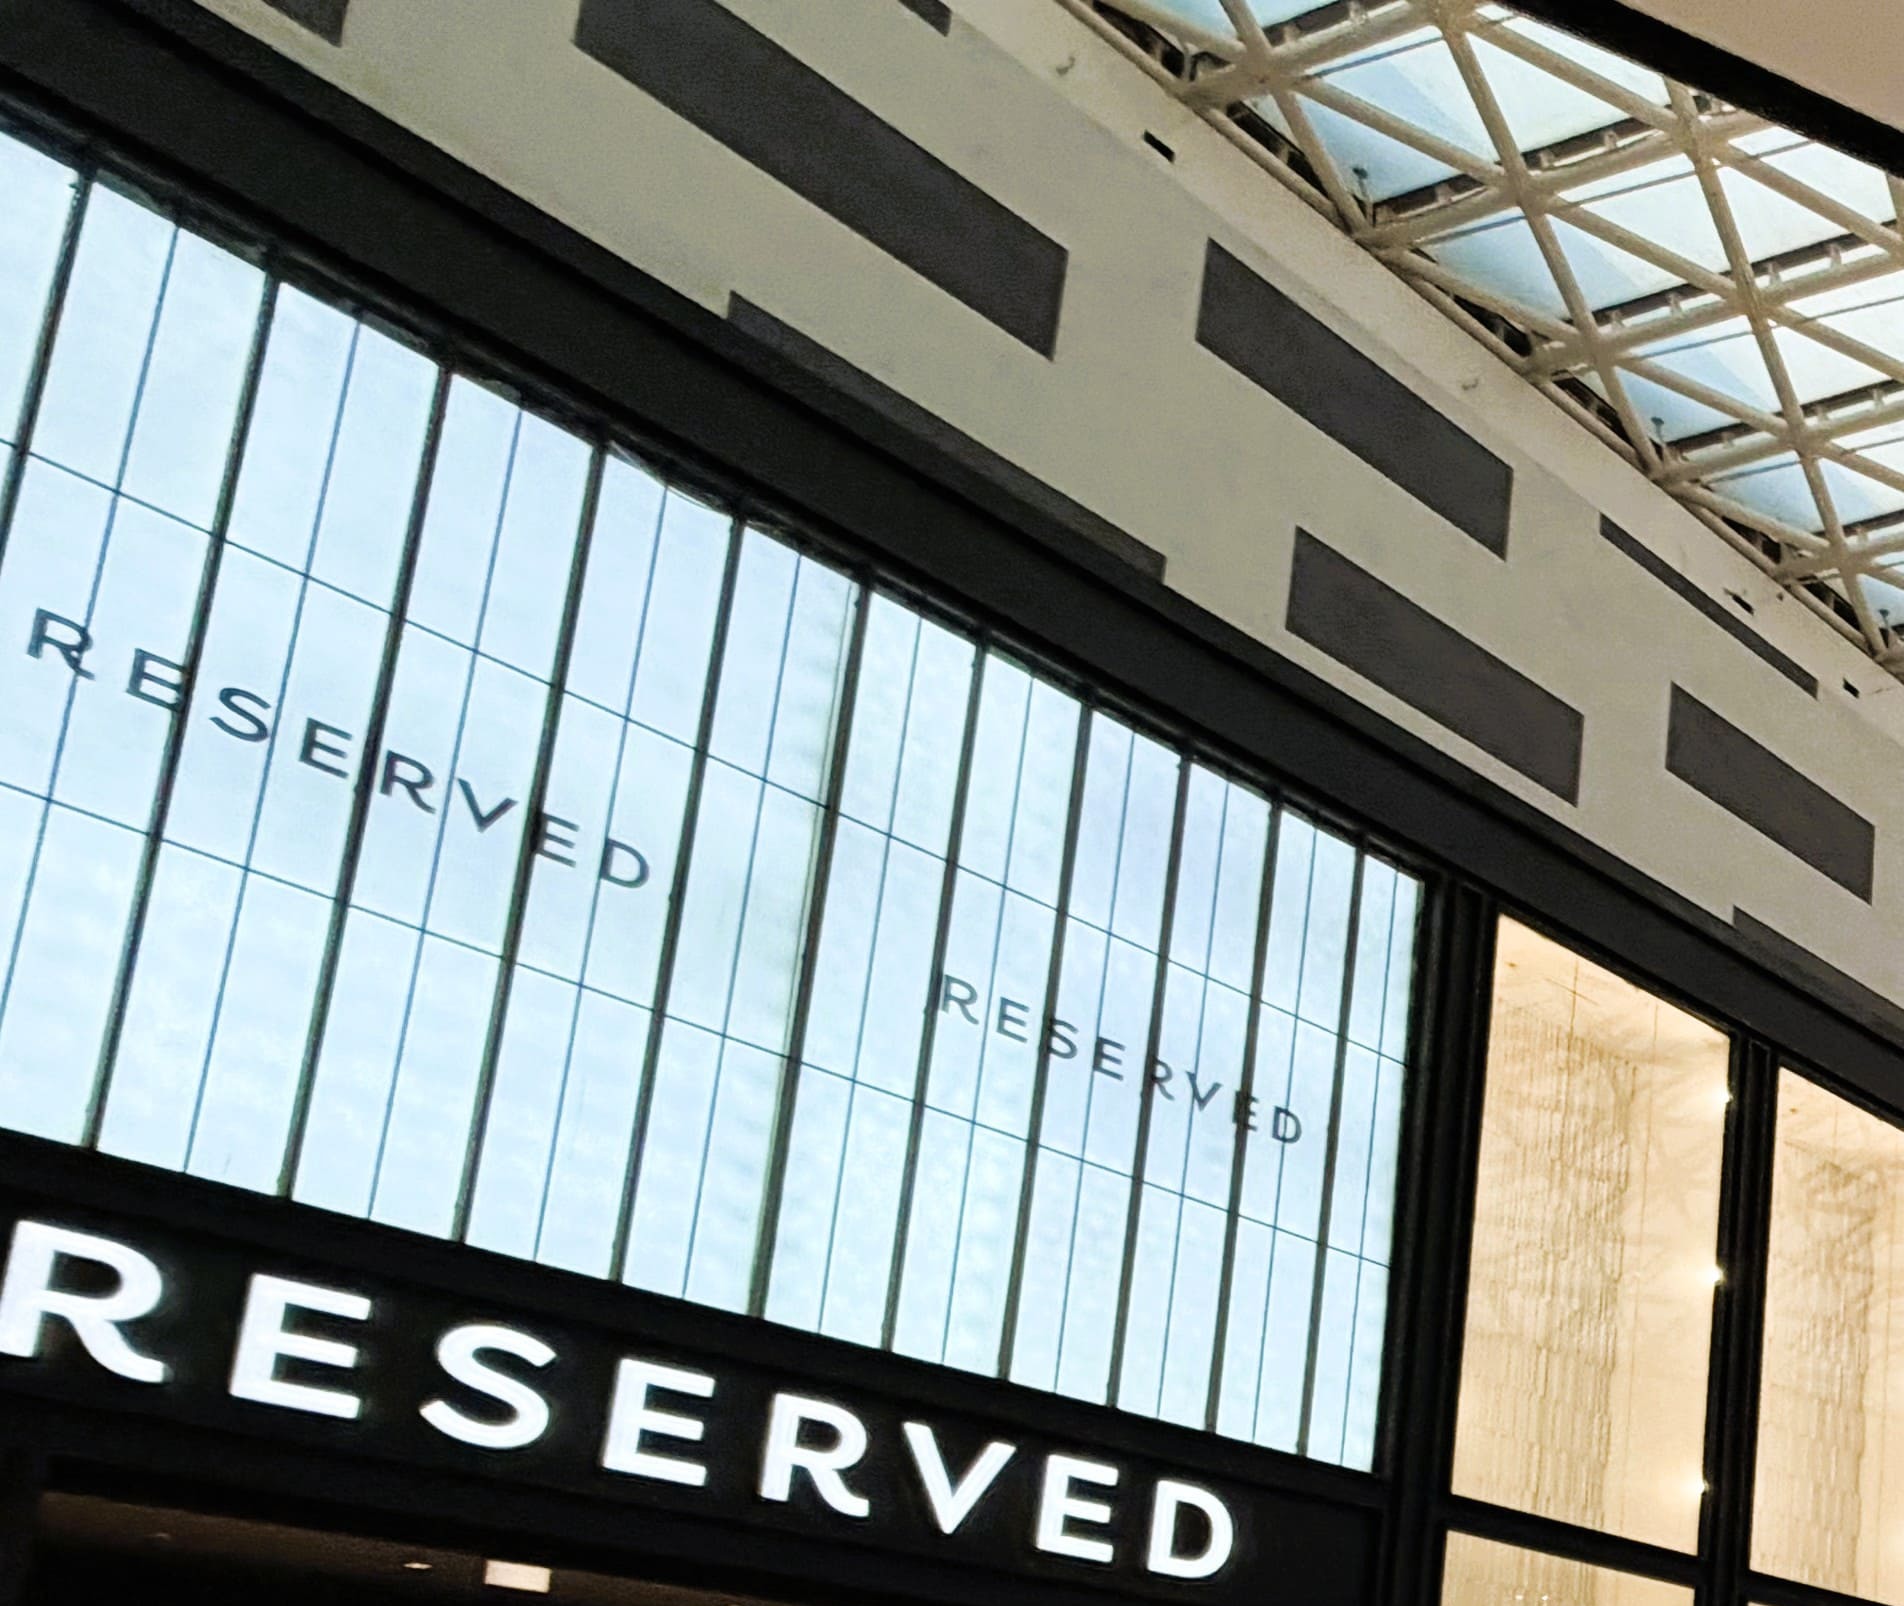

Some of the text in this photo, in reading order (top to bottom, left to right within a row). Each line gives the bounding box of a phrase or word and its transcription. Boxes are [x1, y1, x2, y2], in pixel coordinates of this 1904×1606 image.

[26, 608, 650, 890] RESERVED
[937, 972, 1303, 1147] RESERVED
[0, 1217, 1236, 1581] RESERVED
